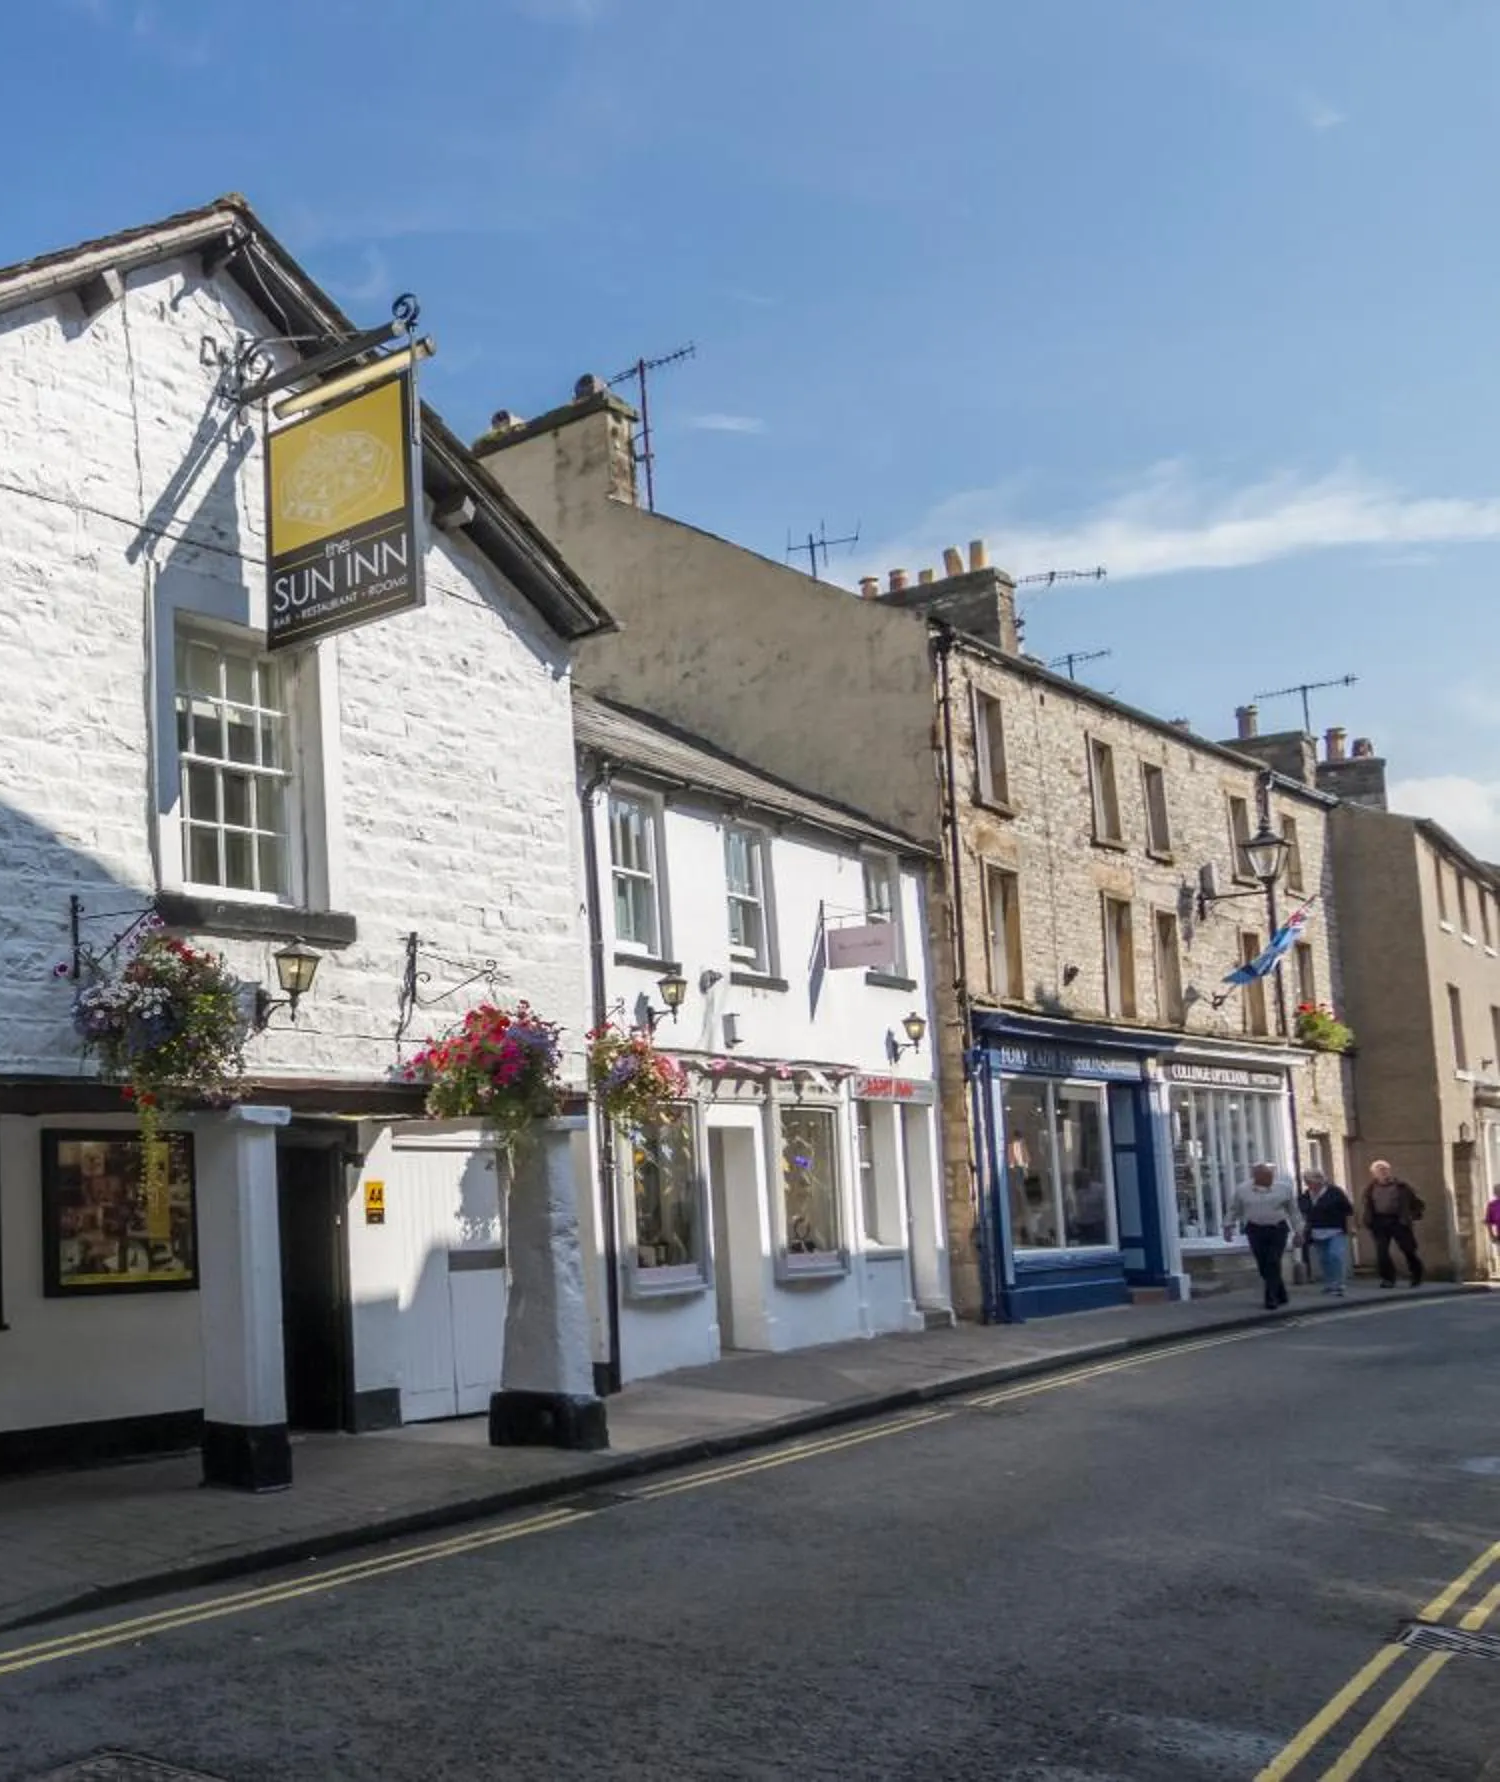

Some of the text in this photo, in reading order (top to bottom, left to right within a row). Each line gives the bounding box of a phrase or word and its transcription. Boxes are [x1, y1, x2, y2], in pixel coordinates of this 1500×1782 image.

[274, 533, 407, 612] SUN INN
[325, 539, 351, 558] the
